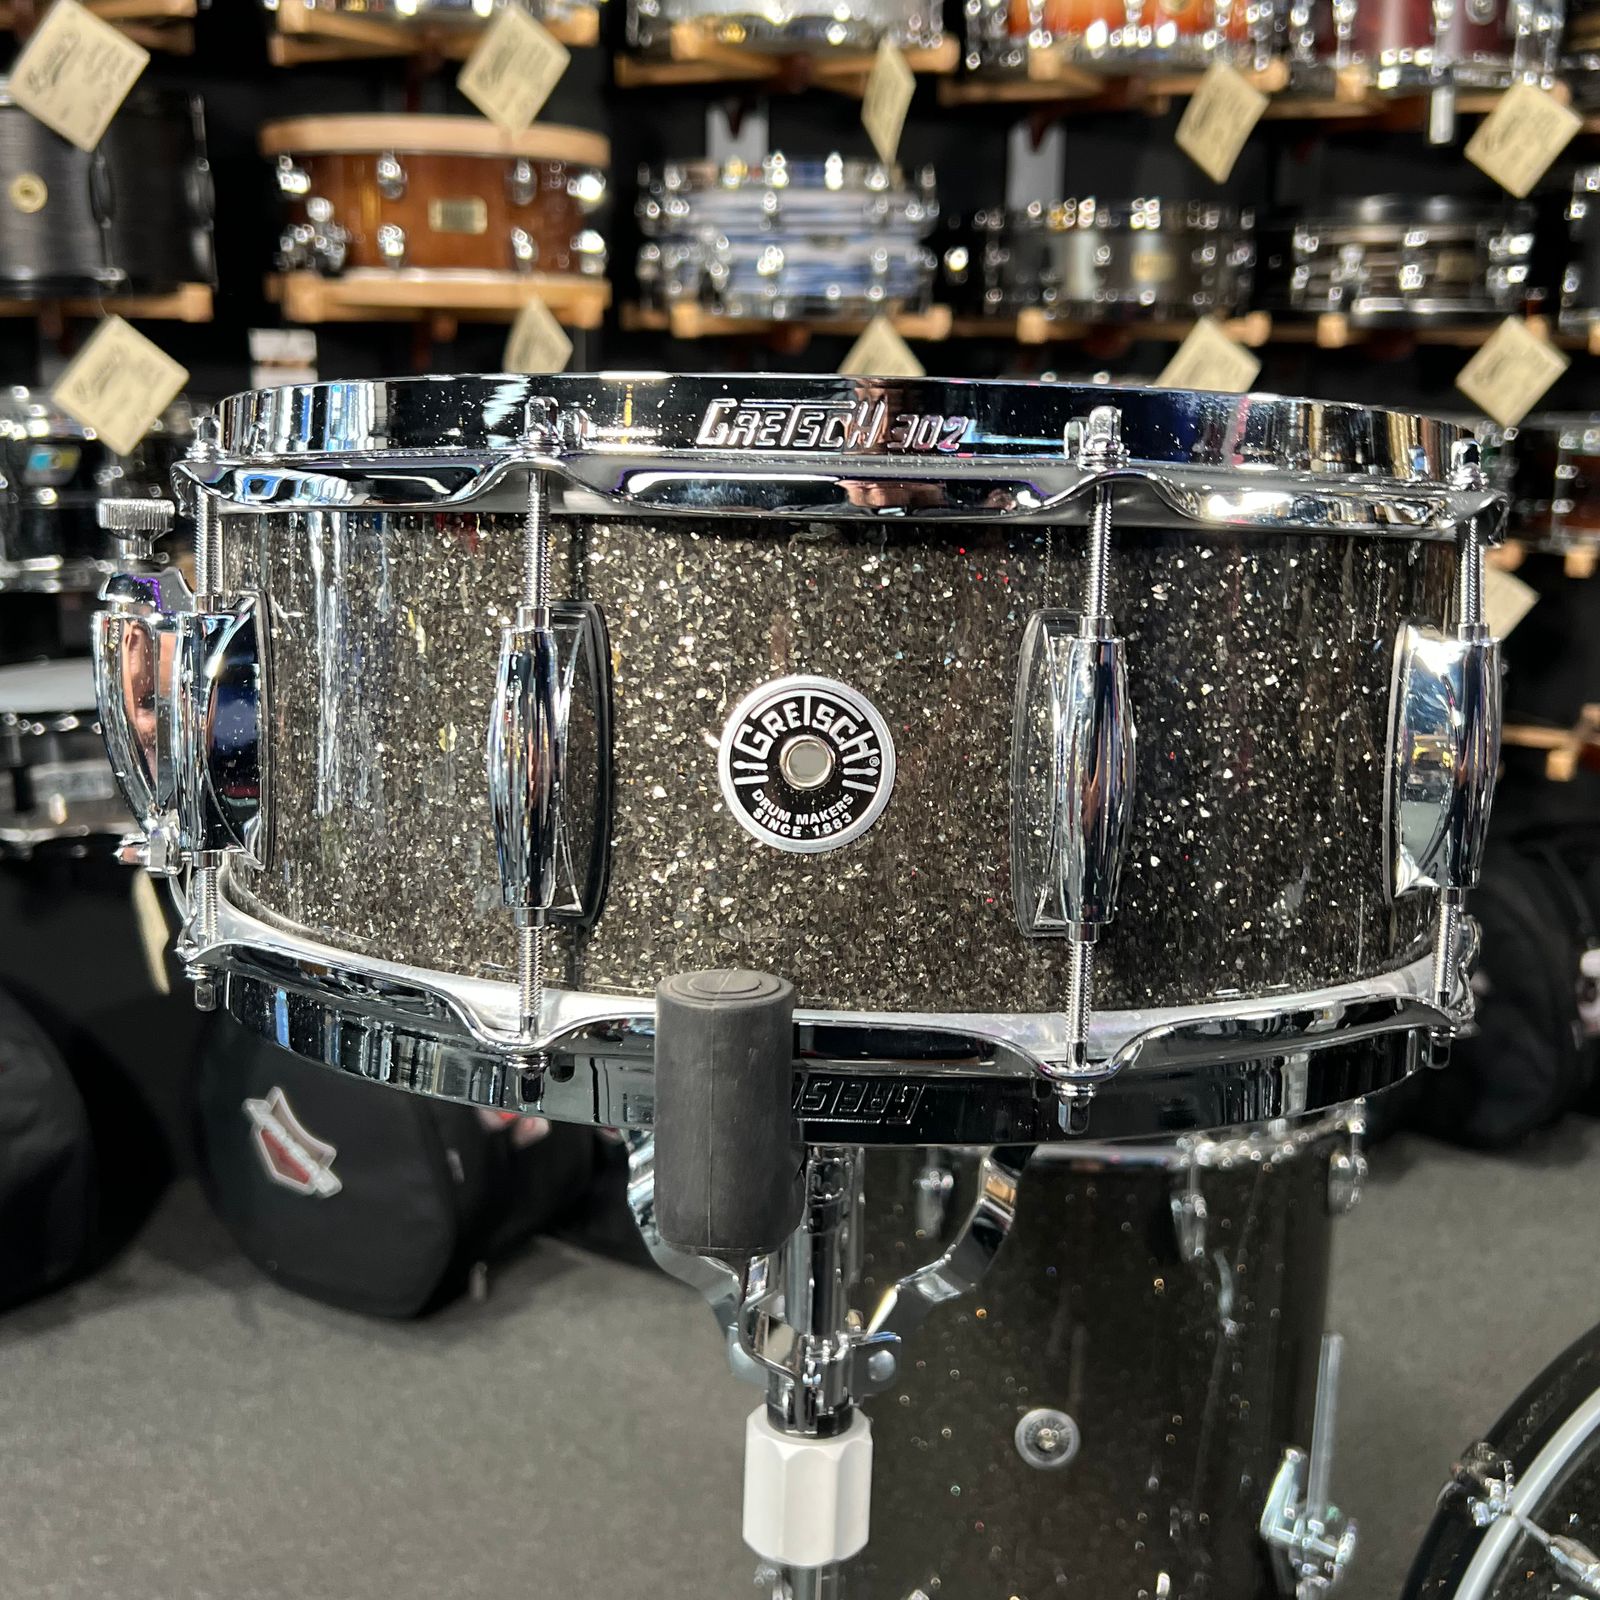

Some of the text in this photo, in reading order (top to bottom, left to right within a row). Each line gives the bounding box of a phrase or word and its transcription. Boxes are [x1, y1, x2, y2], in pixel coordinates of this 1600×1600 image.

[696, 398, 969, 450] GRETSCH 302
[752, 788, 854, 826] DRUM MAKERS
[752, 807, 852, 837] SINCE 1883
[793, 1080, 926, 1124] GRETS
